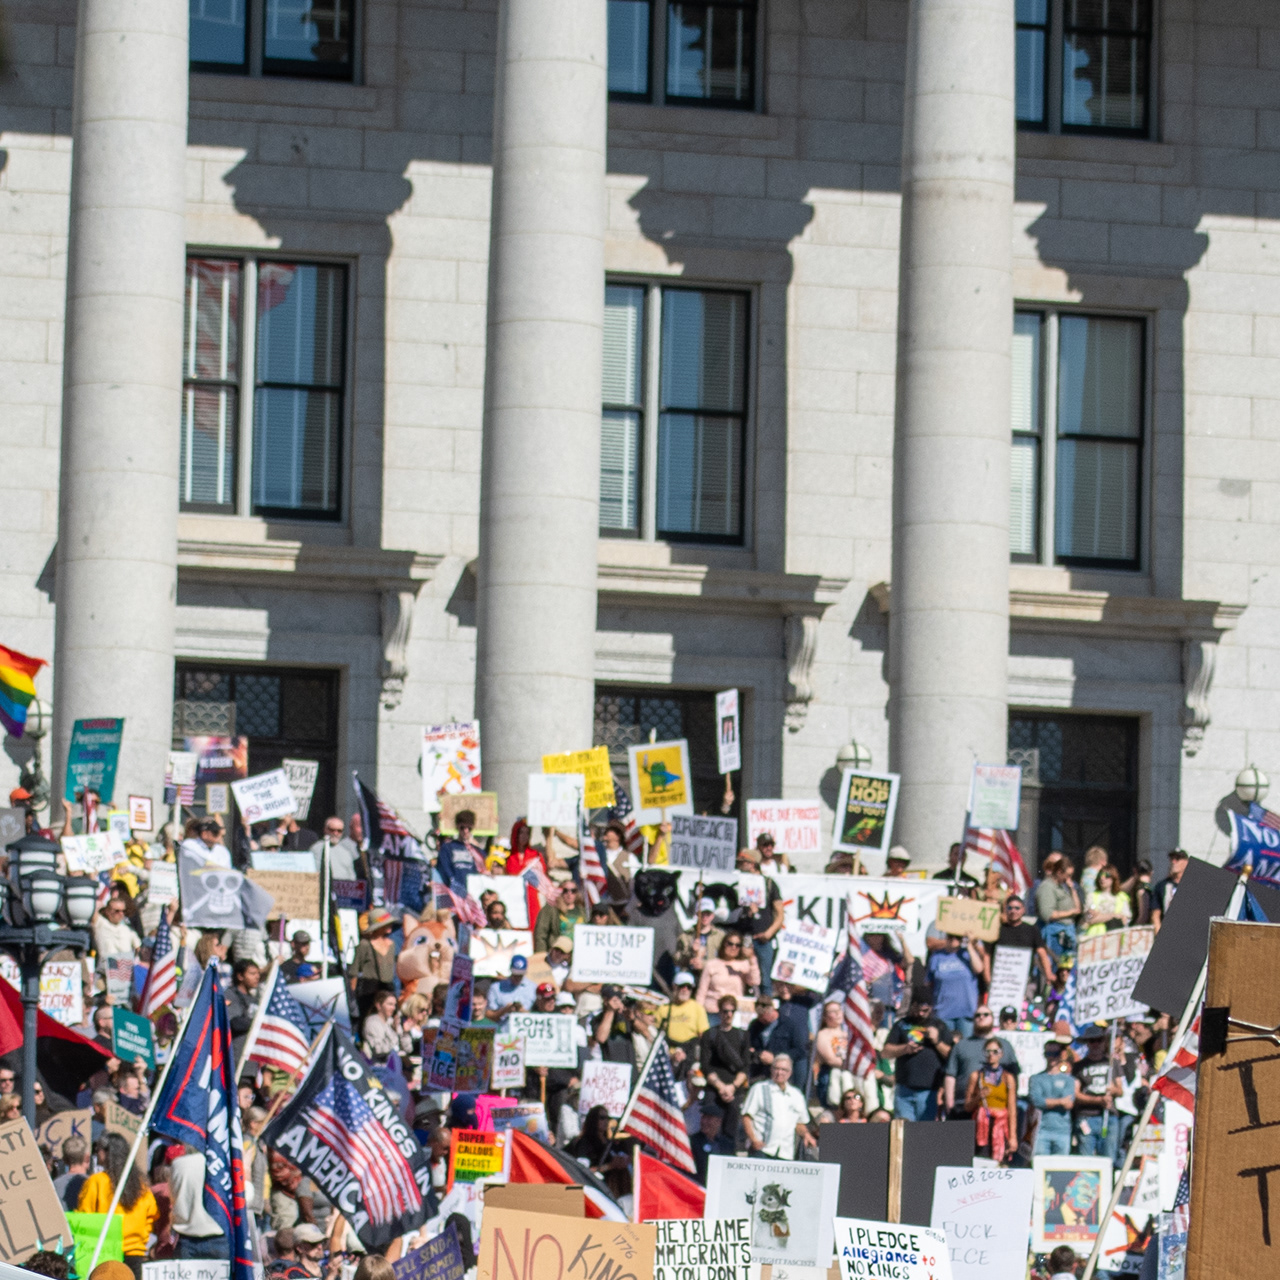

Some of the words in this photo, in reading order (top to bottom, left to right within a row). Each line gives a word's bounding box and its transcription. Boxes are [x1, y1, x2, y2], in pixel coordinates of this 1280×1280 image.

[849, 785, 889, 803] HOP
[750, 807, 773, 822] MAKE
[1240, 818, 1280, 849] NO
[672, 841, 734, 870] TRUMP
[977, 907, 1000, 930] 47
[582, 930, 647, 948] TRUMP
[605, 950, 623, 966] IS
[1079, 967, 1096, 985] MY
[1097, 961, 1125, 979] GAY
[1078, 1003, 1102, 1020] HIS
[513, 1016, 554, 1029] SOME
[337, 1046, 364, 1081] NO
[499, 1054, 520, 1067] NO
[594, 1065, 619, 1078] LOVE
[586, 1078, 627, 1091] AMERICA
[363, 1087, 418, 1159] KINGS
[458, 1132, 486, 1142] SUPER
[457, 1145, 495, 1157] CALLOUS
[456, 1158, 492, 1170] FASCIST
[726, 1161, 750, 1171] BORN
[751, 1163, 765, 1172] TO
[766, 1164, 792, 1174] DILLY
[792, 1166, 822, 1176] DALLY
[275, 1124, 369, 1234] AMERICA
[415, 1165, 431, 1197] IN
[692, 1217, 750, 1243] BLAME
[611, 1233, 639, 1261] 1776
[848, 1227, 855, 1244] I
[857, 1228, 921, 1252] PLEDGE
[760, 1257, 782, 1266] FIGHT
[783, 1258, 817, 1267] FASCISTS
[842, 1245, 918, 1265] Allegiance
[162, 1264, 193, 1280] take
[847, 1260, 865, 1275] NO
[867, 1261, 911, 1280] KINGS
